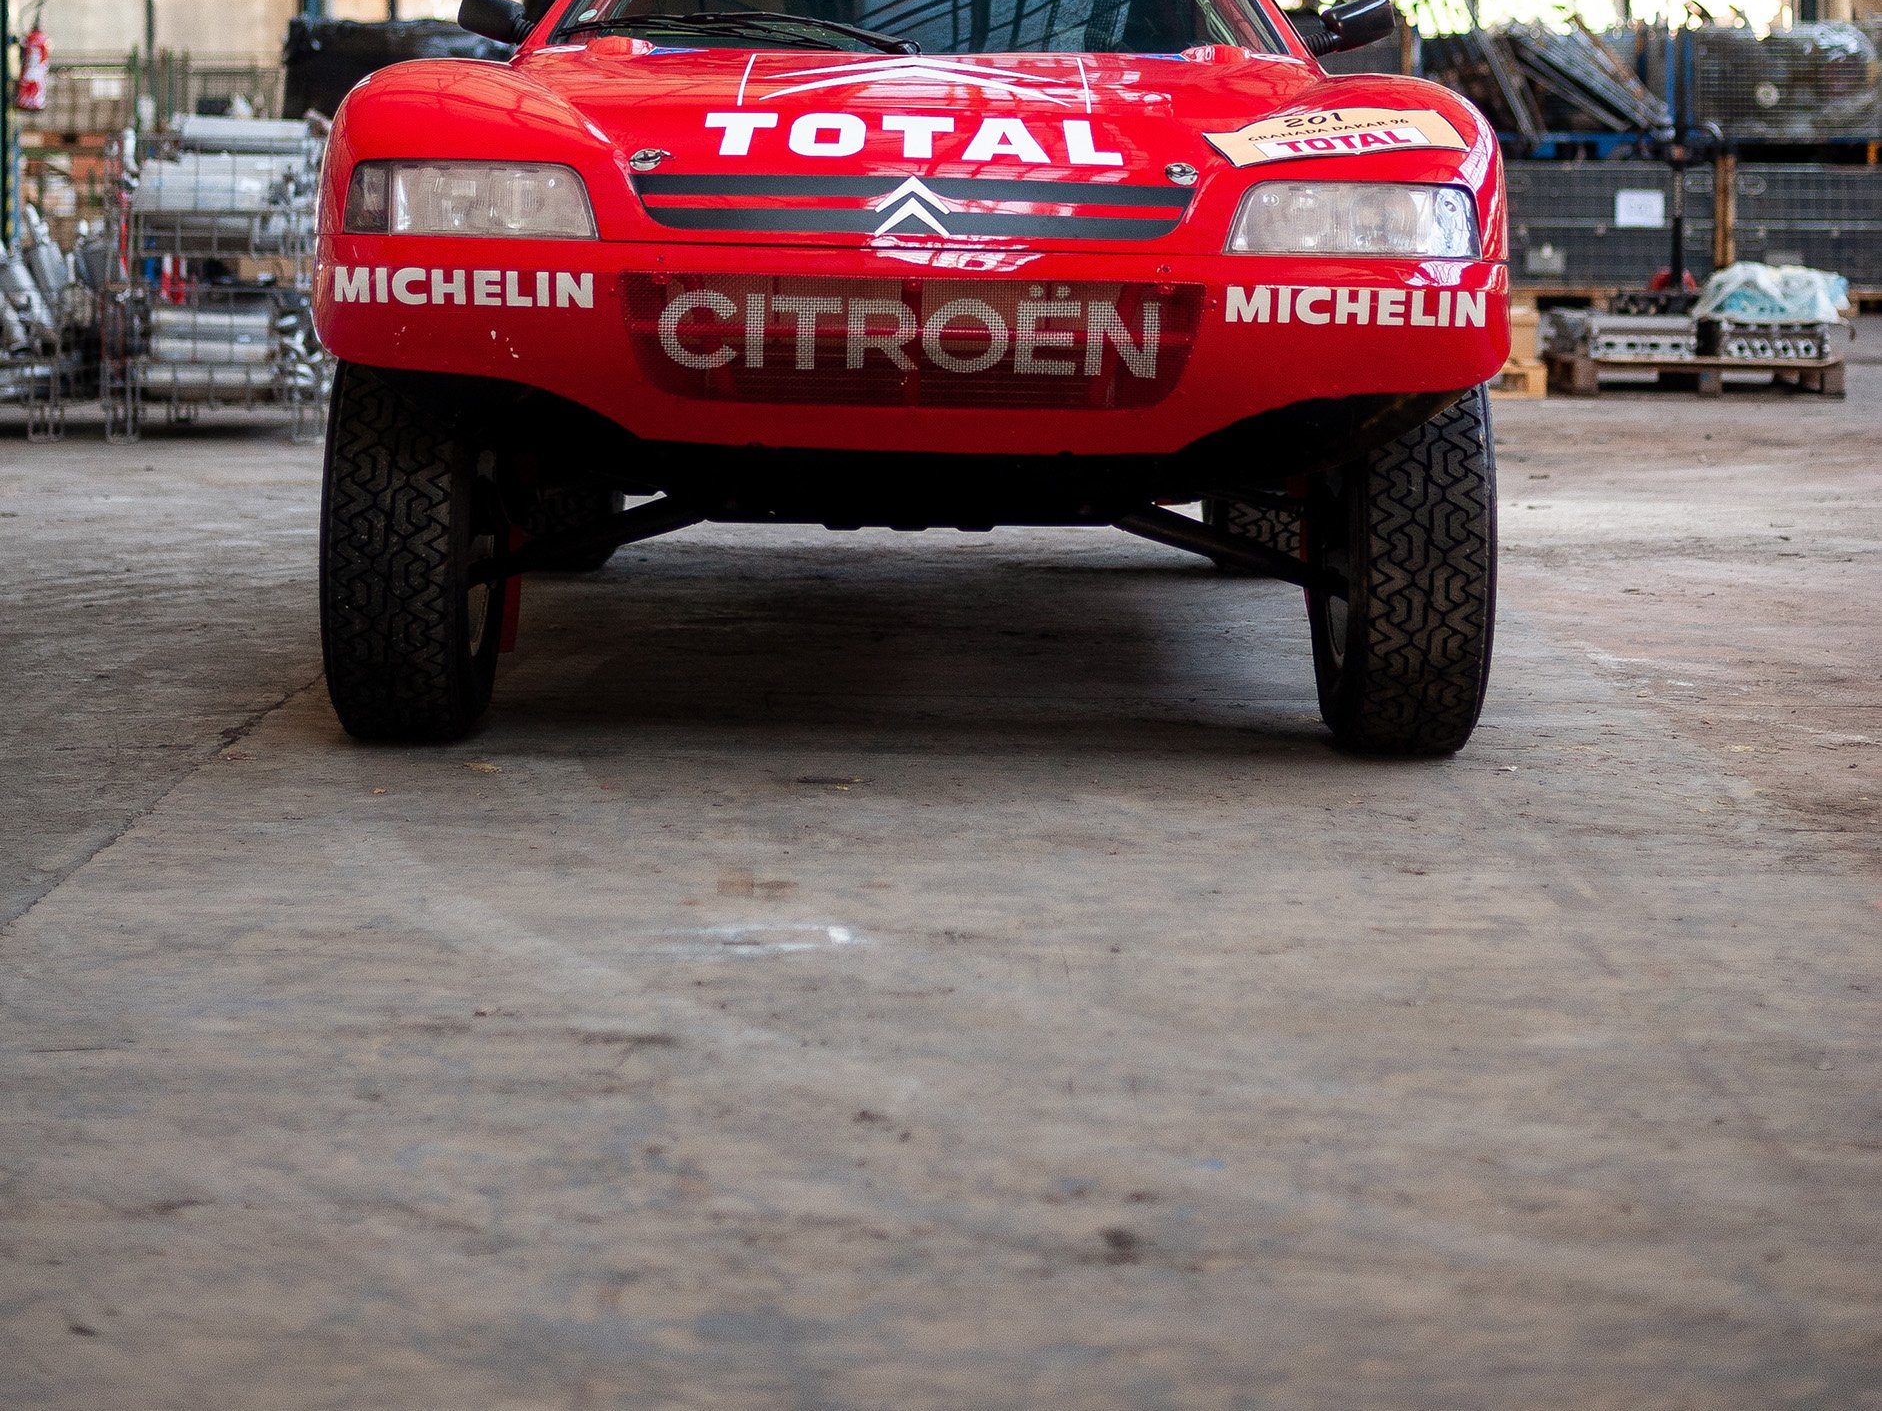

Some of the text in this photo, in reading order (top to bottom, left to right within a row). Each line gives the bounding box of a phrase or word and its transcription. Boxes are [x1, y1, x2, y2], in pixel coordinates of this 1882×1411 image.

[705, 112, 1124, 166] TOTAL
[1248, 118, 1409, 141] GRANADA DAKAR 96
[1283, 112, 1344, 128] 201
[1276, 130, 1412, 153] TOTAL
[334, 266, 594, 308] MICHELIN
[1225, 286, 1486, 327] MICHELIN
[658, 285, 1162, 379] CITROËN
